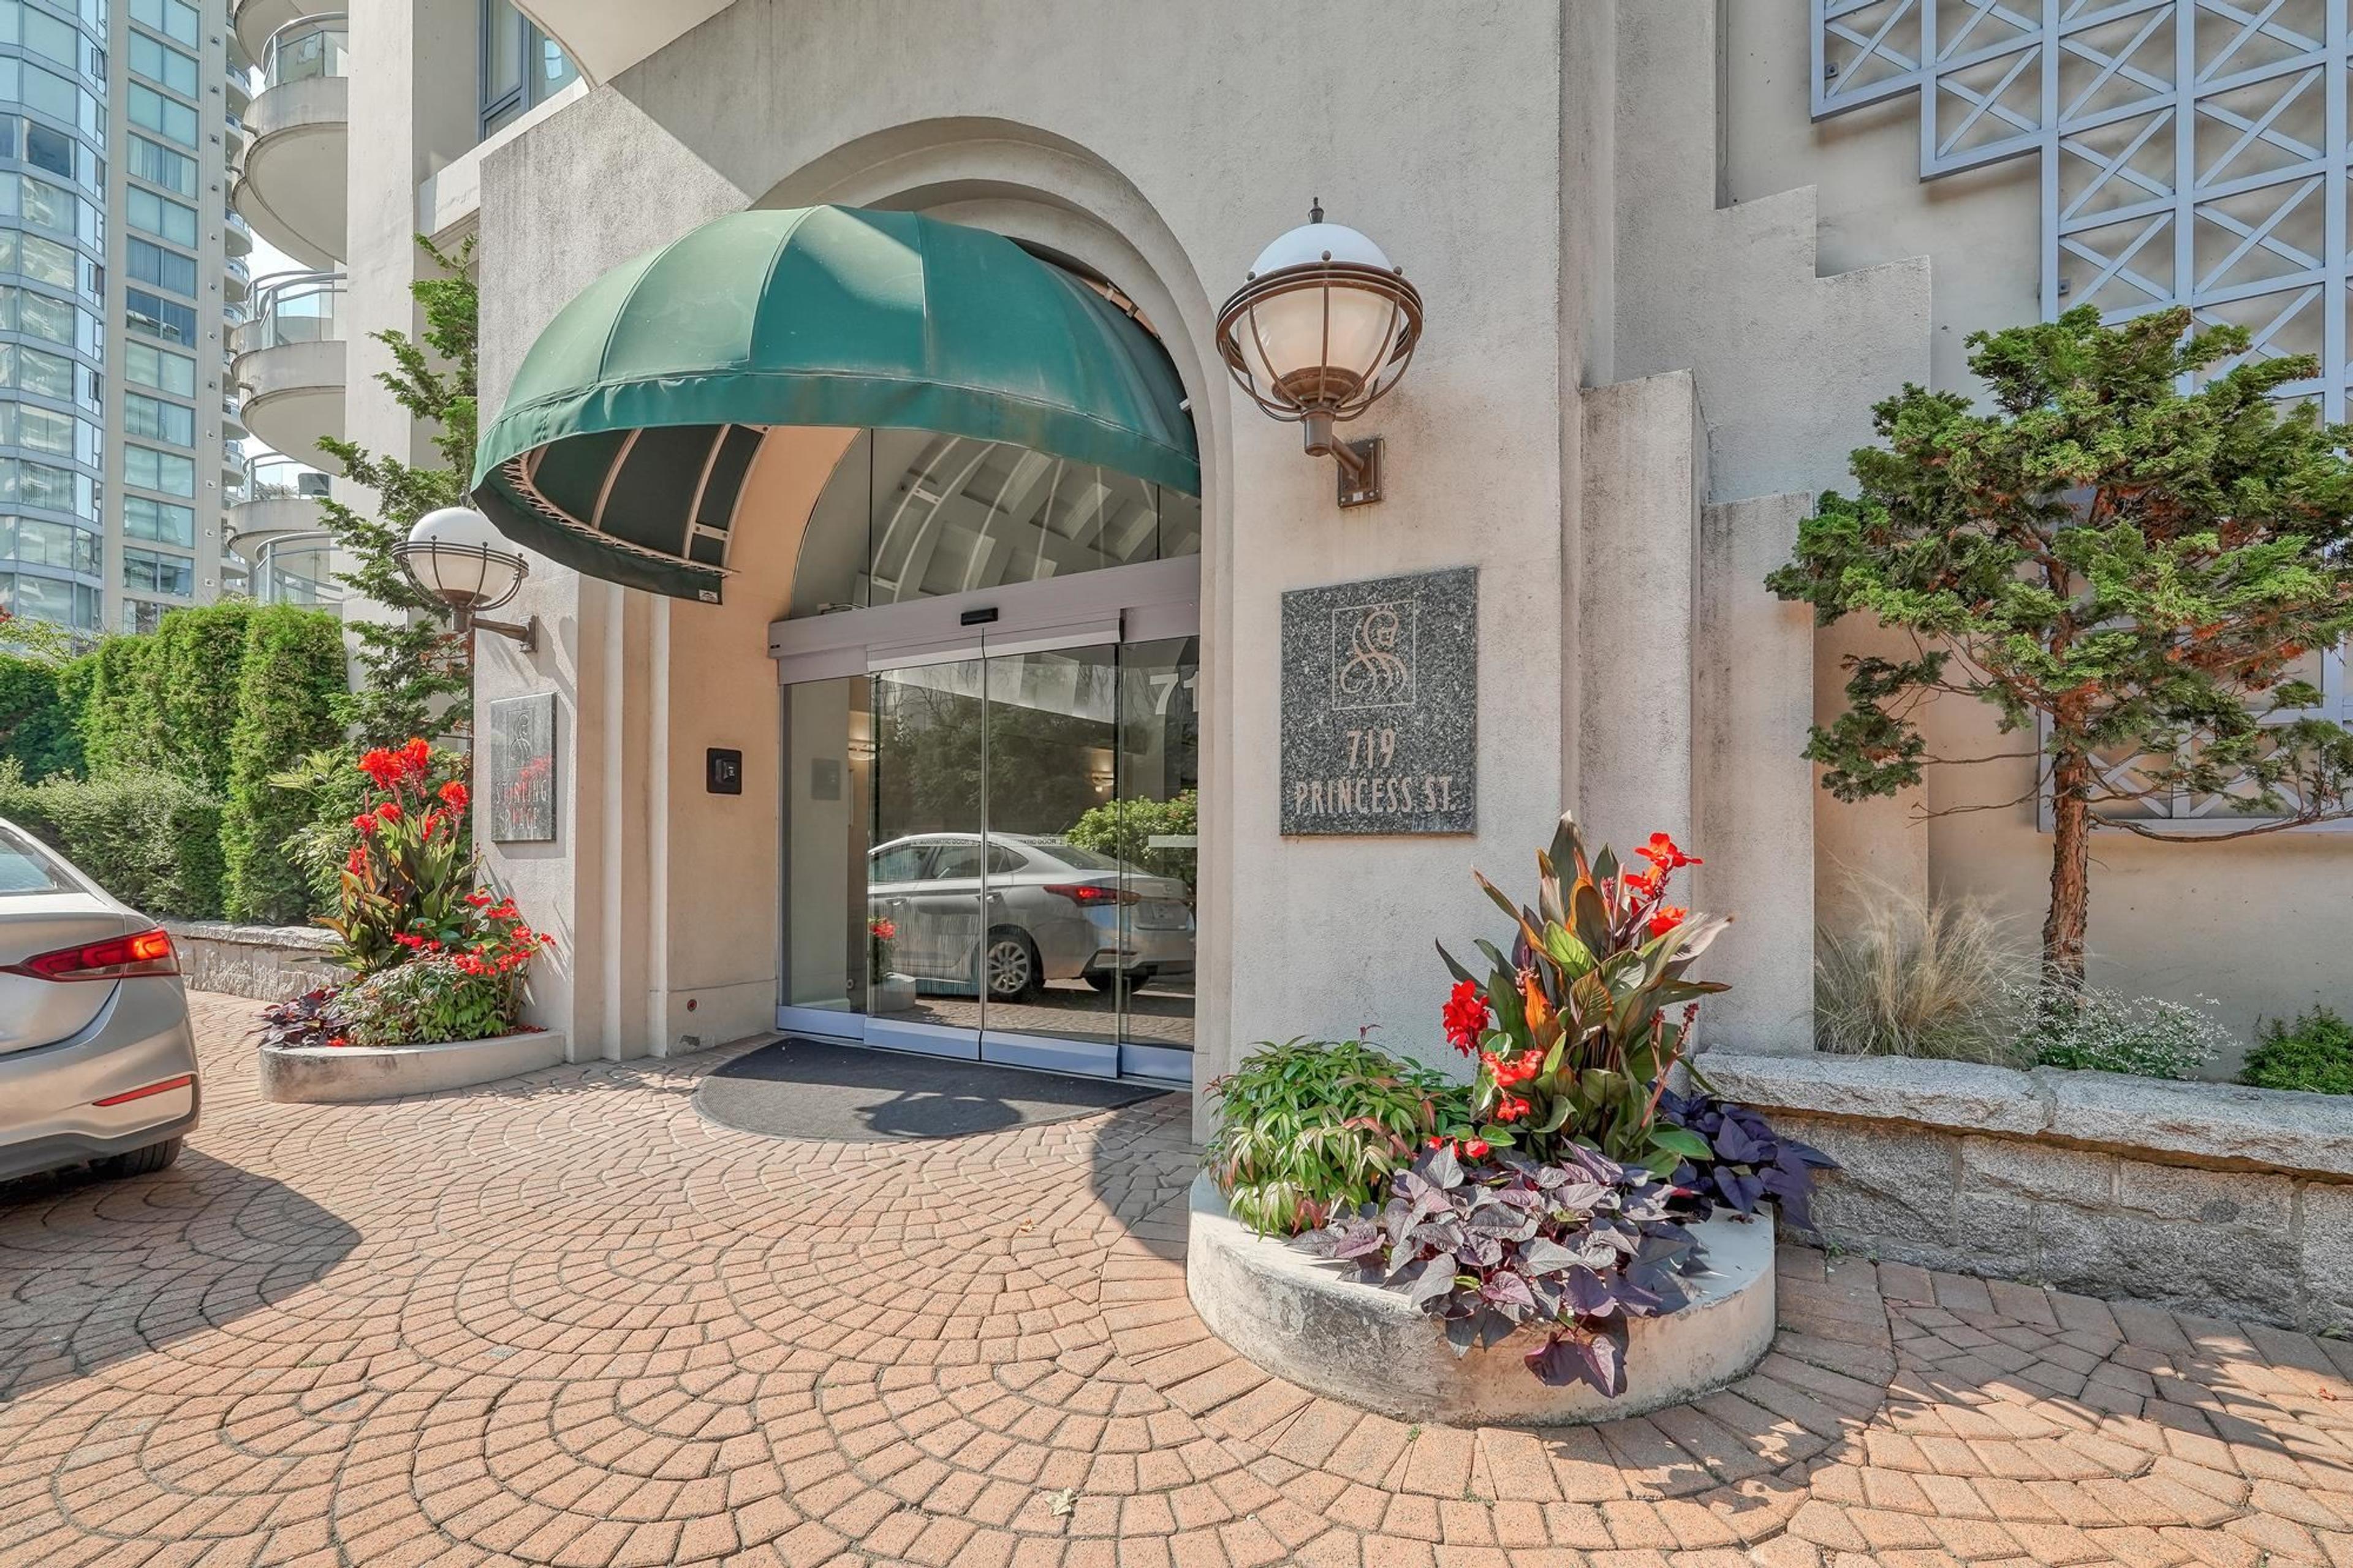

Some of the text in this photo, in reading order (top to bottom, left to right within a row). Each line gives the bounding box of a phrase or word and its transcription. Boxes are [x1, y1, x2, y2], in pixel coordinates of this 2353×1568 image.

[1347, 728, 1396, 770] 719
[1295, 775, 1456, 814] PRINCESS ST.
